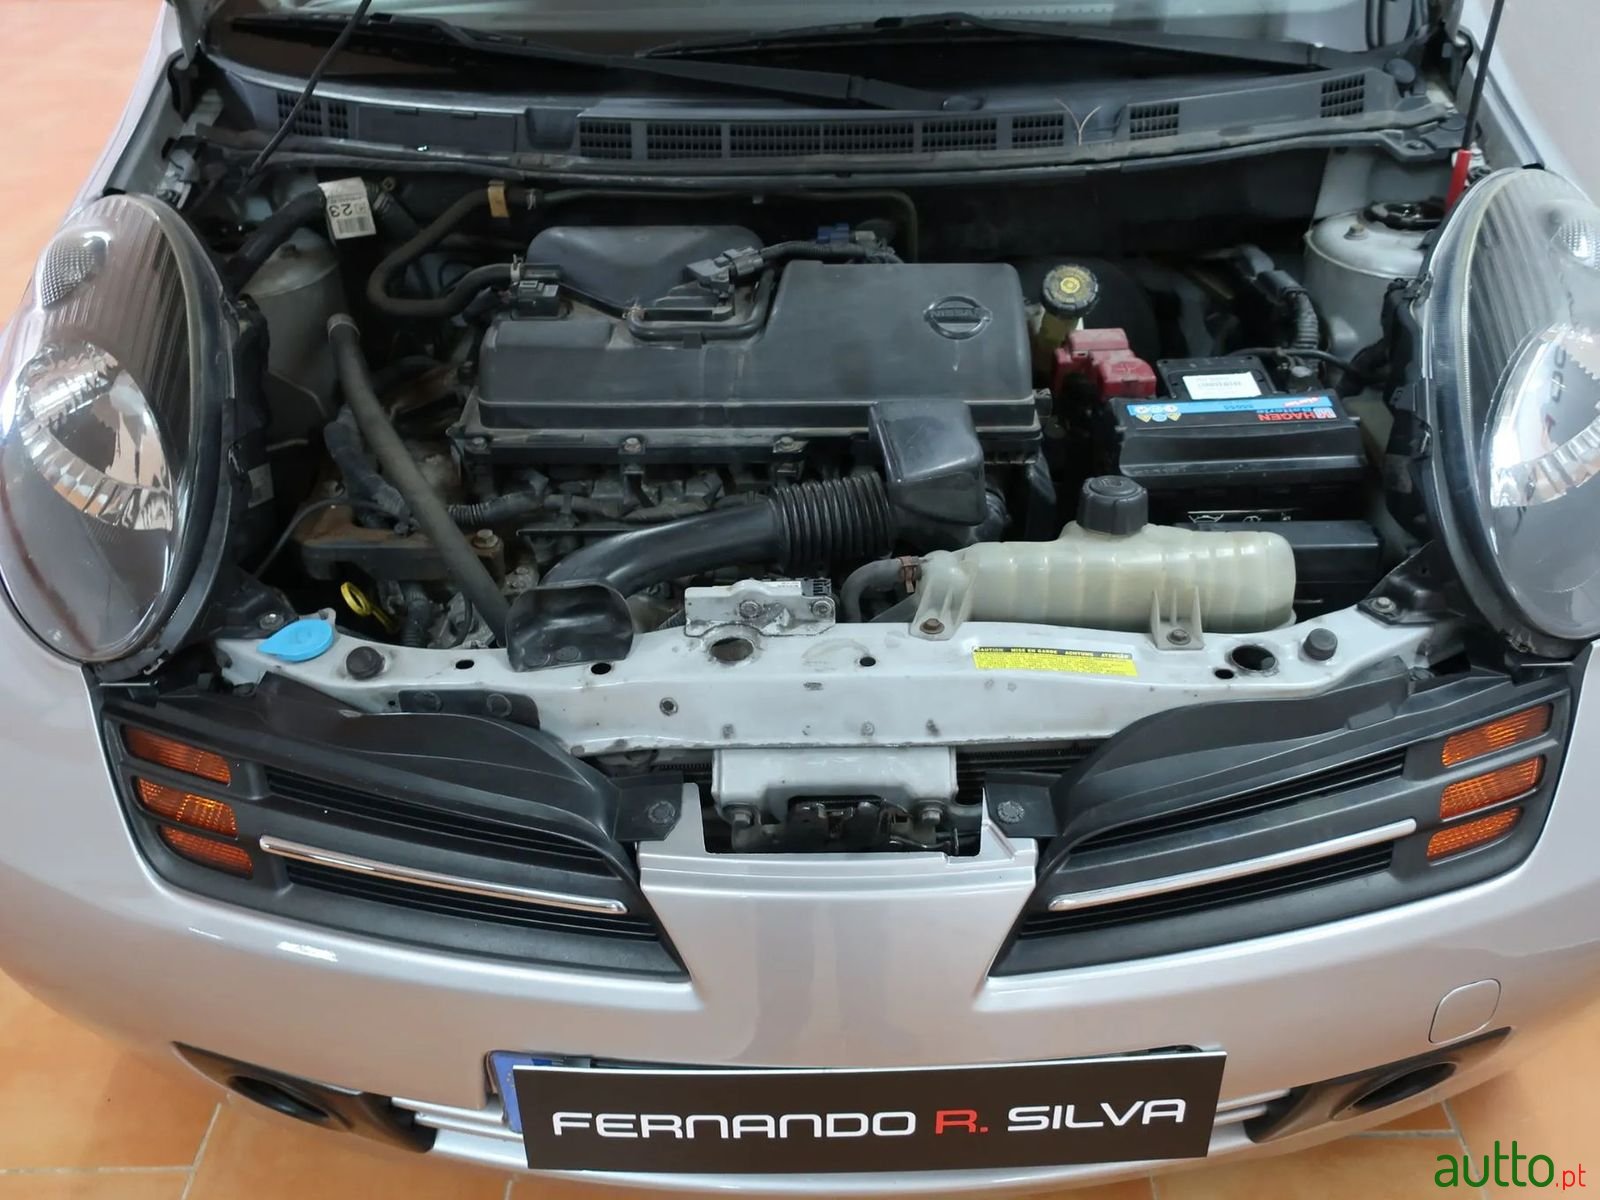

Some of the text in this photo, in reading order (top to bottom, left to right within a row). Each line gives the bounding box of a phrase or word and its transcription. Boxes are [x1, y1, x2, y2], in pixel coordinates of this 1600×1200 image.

[329, 203, 352, 217] 23
[1258, 411, 1316, 421] HAGEN
[552, 1098, 1187, 1139] FERNANDO R. SILVA
